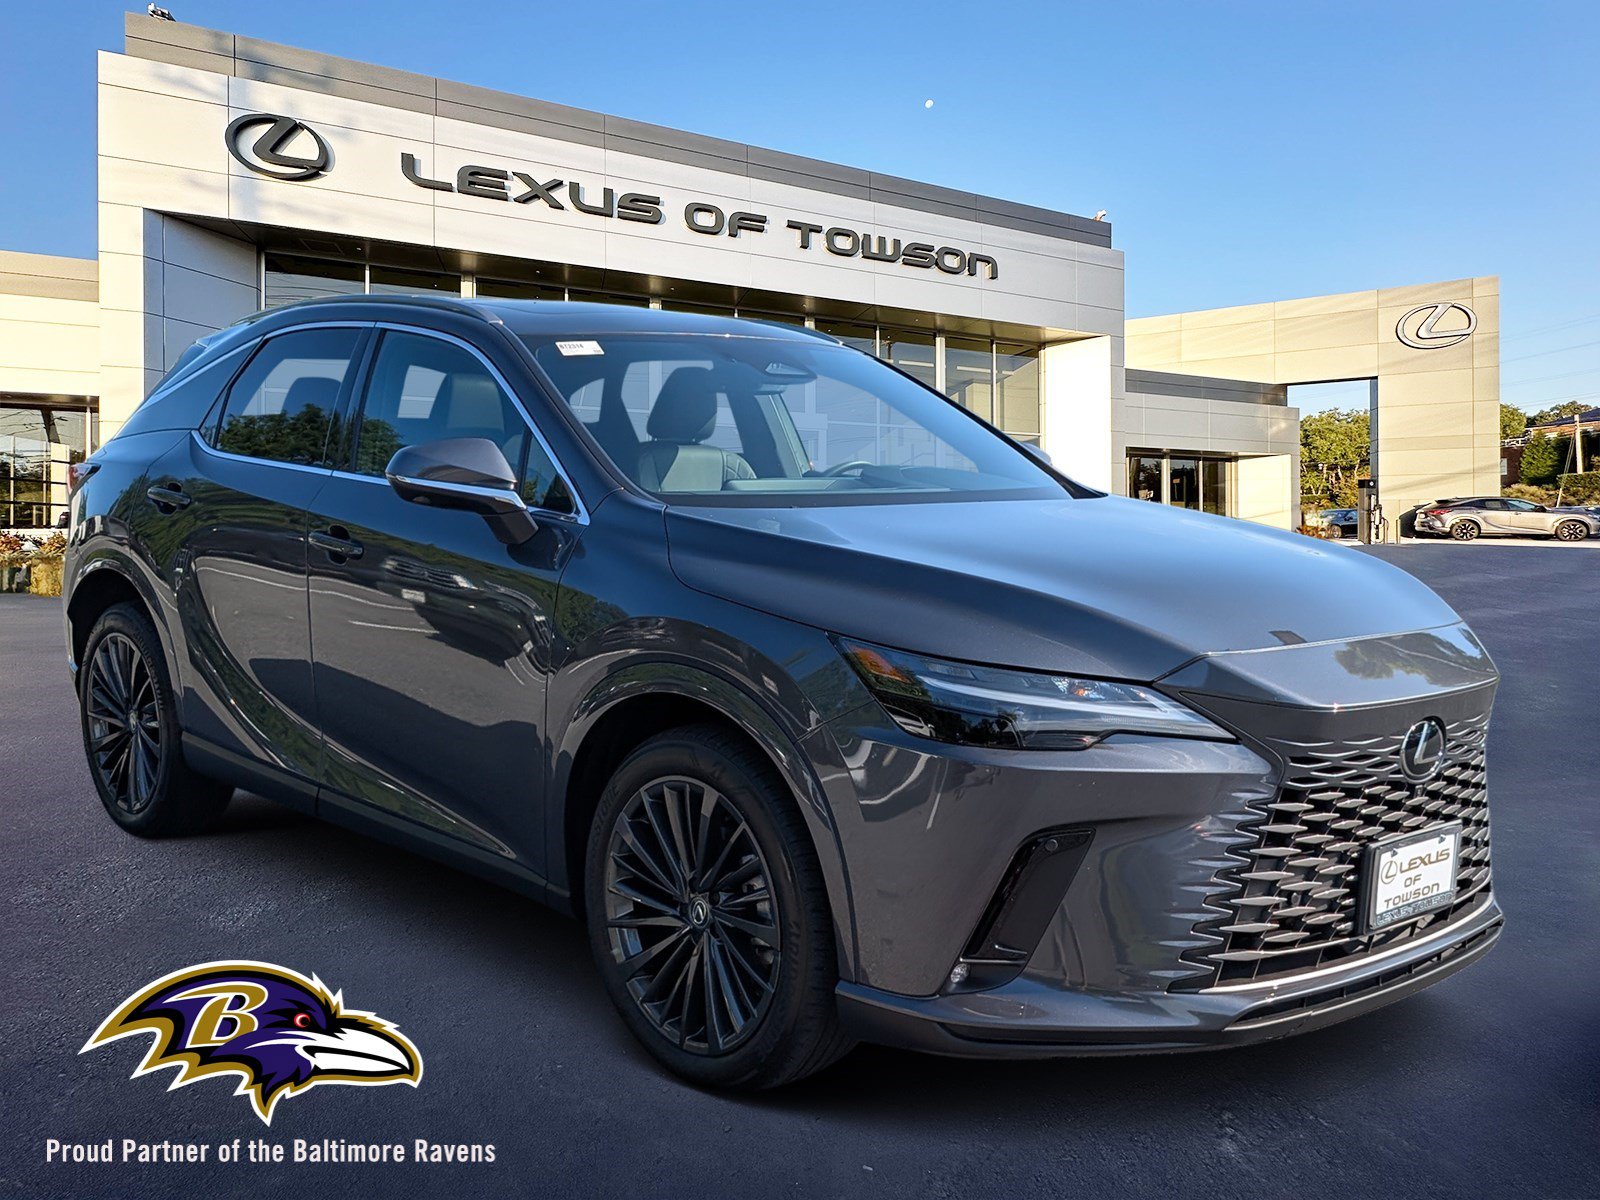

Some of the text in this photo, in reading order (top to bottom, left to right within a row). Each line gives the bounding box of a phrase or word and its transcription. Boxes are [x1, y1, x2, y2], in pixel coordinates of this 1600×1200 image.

[401, 152, 999, 280] LEXUS OF TOWSON
[1399, 848, 1450, 873] LEXUS
[1404, 874, 1422, 888] OF
[1384, 882, 1440, 909] TOWSON
